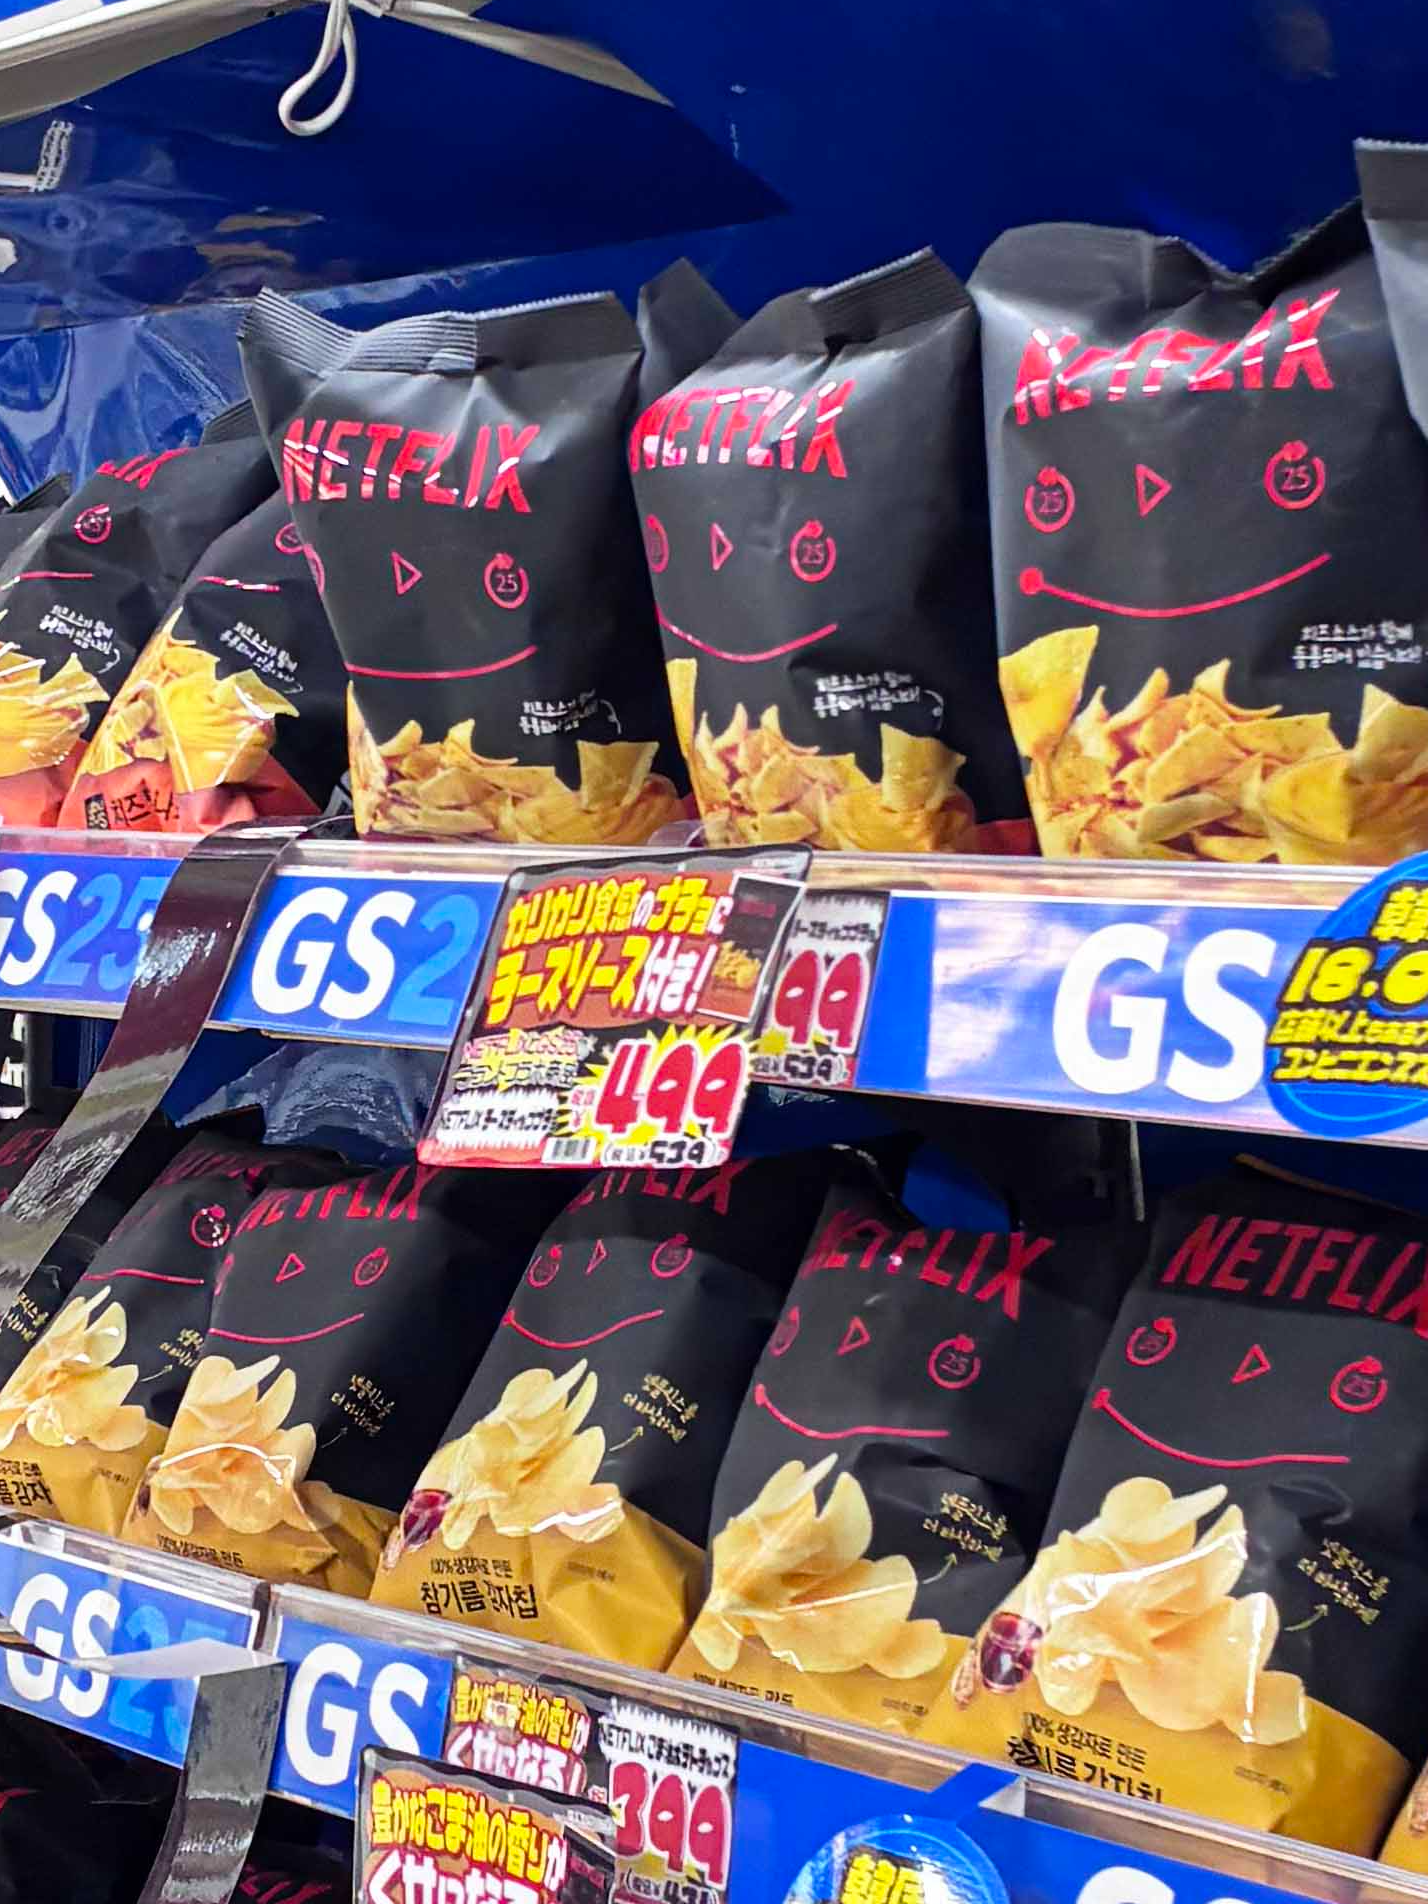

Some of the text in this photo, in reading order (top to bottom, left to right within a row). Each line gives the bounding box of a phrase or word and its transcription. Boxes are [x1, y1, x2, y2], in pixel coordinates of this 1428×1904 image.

[1015, 288, 1340, 426] NETFLIX
[282, 418, 541, 514] NETFLIX
[629, 378, 857, 479] NETFLIX
[252, 886, 484, 1028] GS2
[1052, 921, 1276, 1102] GS
[594, 1040, 748, 1135] 499
[234, 1164, 442, 1238] NETFLIX
[801, 1211, 1054, 1323] NETFLIX
[14, 1476, 53, 1507] 감자
[420, 1578, 483, 1616] 참기름
[284, 1642, 430, 1790] GS
[1055, 1717, 1114, 1754] 생감자로
[1115, 1741, 1147, 1769] 만든
[371, 1778, 568, 1893] 豊かなごま油の香りが
[610, 1760, 732, 1888] 399
